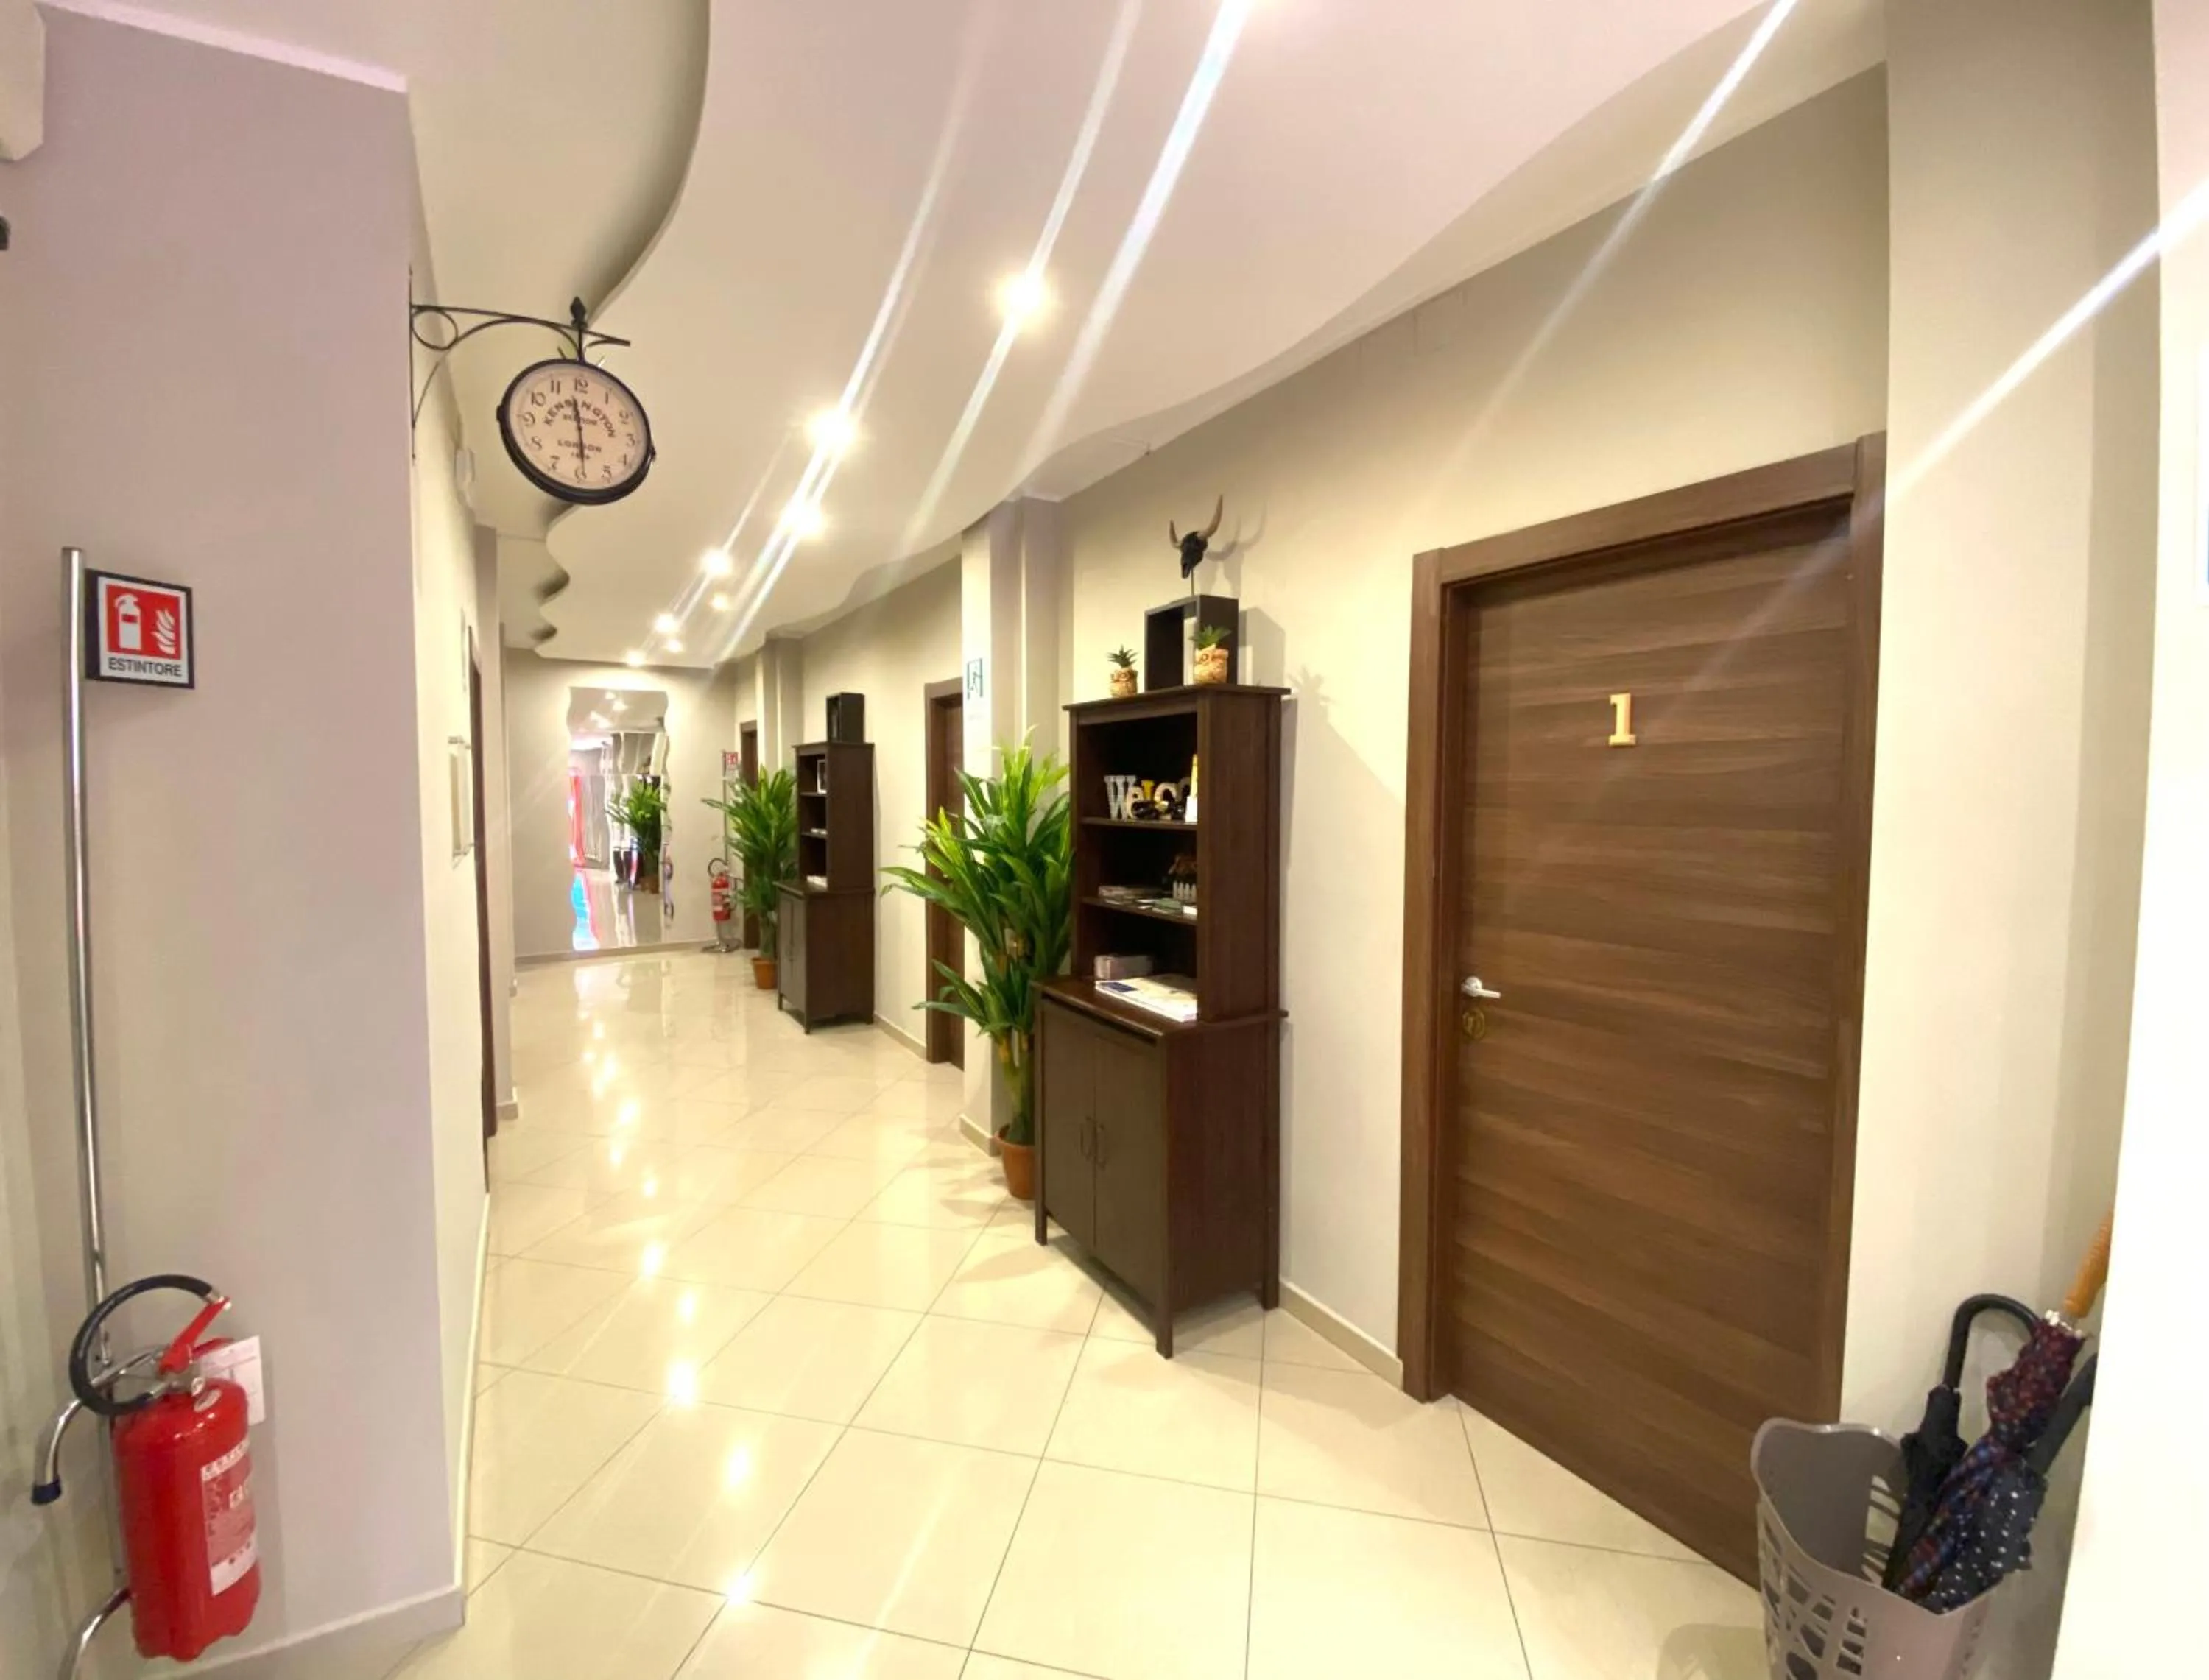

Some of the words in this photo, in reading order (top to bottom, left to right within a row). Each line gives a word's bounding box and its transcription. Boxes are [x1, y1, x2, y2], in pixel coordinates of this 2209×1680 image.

[550, 379, 560, 395] 11
[574, 378, 588, 395] 12
[531, 391, 546, 406] 10
[605, 392, 610, 405] 1
[524, 412, 535, 427] 9
[543, 398, 616, 438] KENSNGTON
[619, 410, 629, 425] 2
[626, 433, 635, 448] 3
[602, 465, 612, 481] 5
[108, 657, 183, 677] ESTINTORE
[1608, 693, 1638, 747] 1
